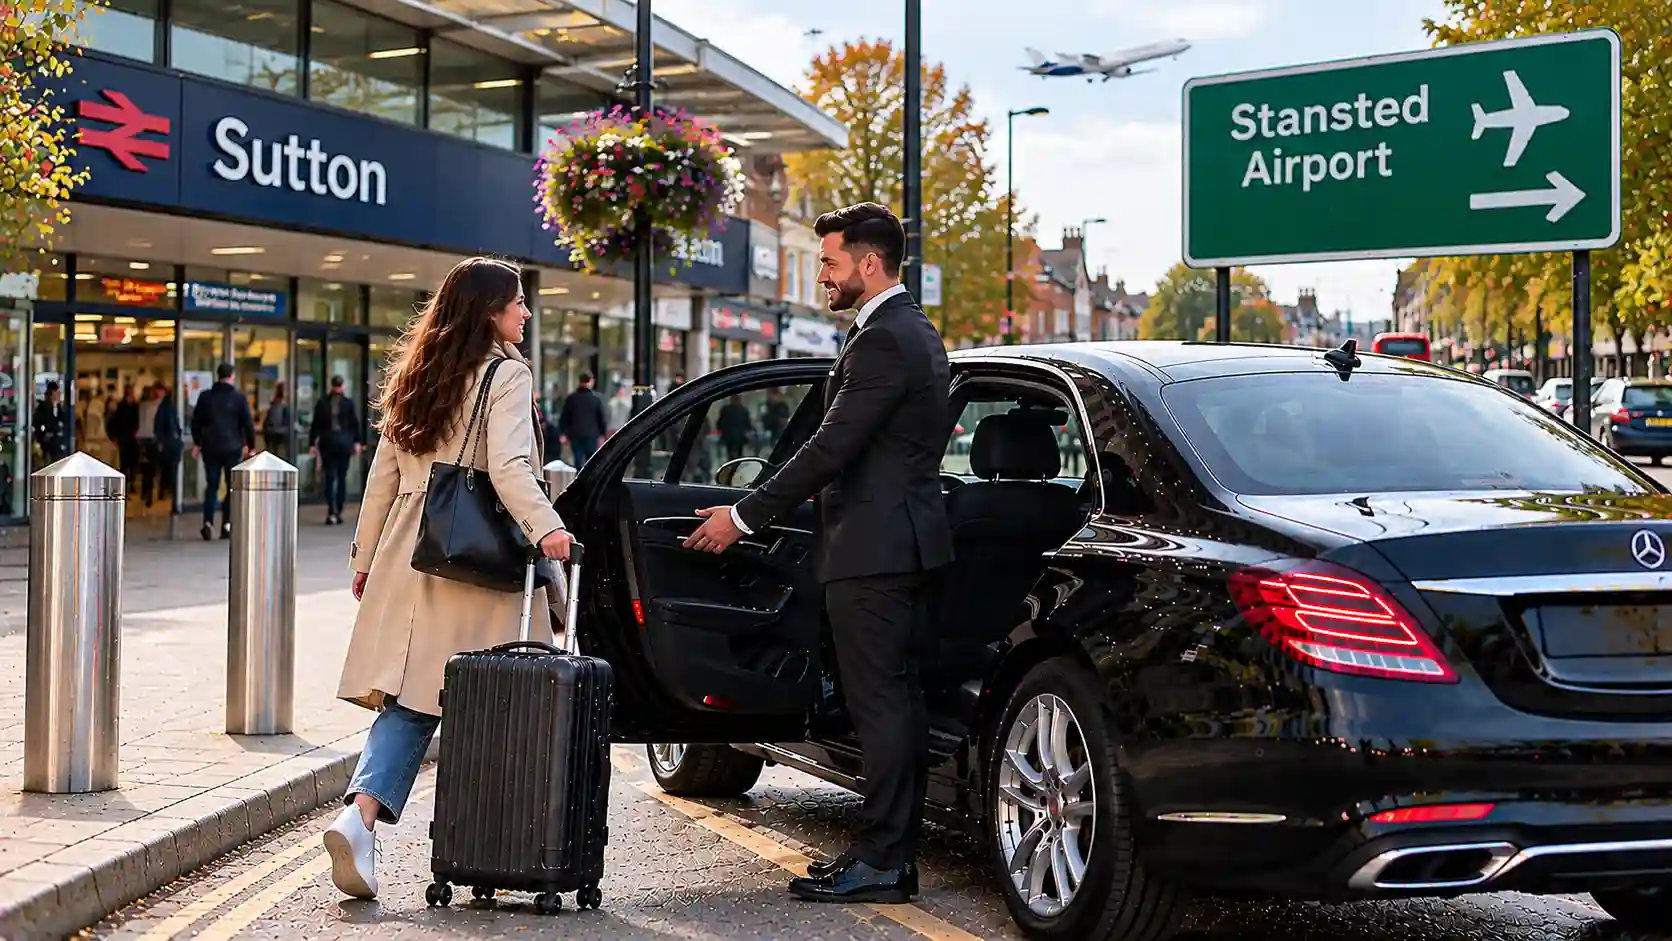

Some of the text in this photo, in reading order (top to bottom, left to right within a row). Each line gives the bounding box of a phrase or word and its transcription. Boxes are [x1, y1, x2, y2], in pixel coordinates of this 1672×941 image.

[1230, 84, 1429, 141] Stansted
[213, 116, 387, 205] Sutton
[1241, 141, 1393, 192] Airport
